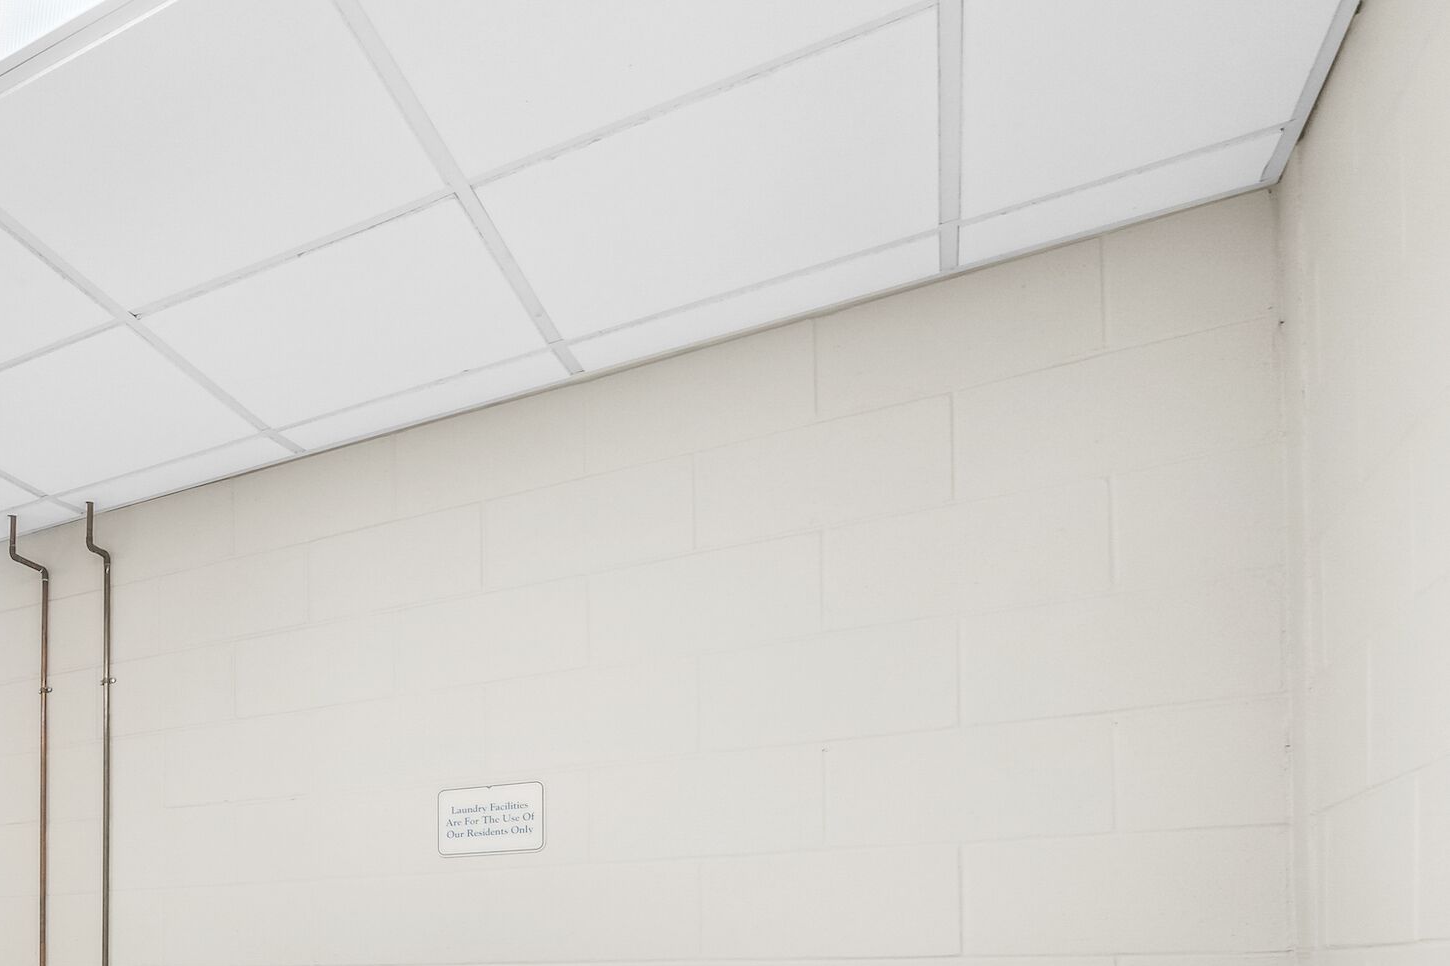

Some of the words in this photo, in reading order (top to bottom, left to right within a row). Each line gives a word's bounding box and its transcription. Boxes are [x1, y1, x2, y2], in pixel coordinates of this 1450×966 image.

[451, 805, 487, 815] Laundry
[490, 801, 529, 812] Facilities
[446, 818, 462, 827] Are
[464, 816, 479, 826] For
[482, 814, 500, 824] The
[502, 813, 520, 823] Use
[522, 811, 535, 821] Of
[446, 829, 464, 839] Our
[467, 827, 509, 838] Residents
[510, 825, 534, 834] Only
